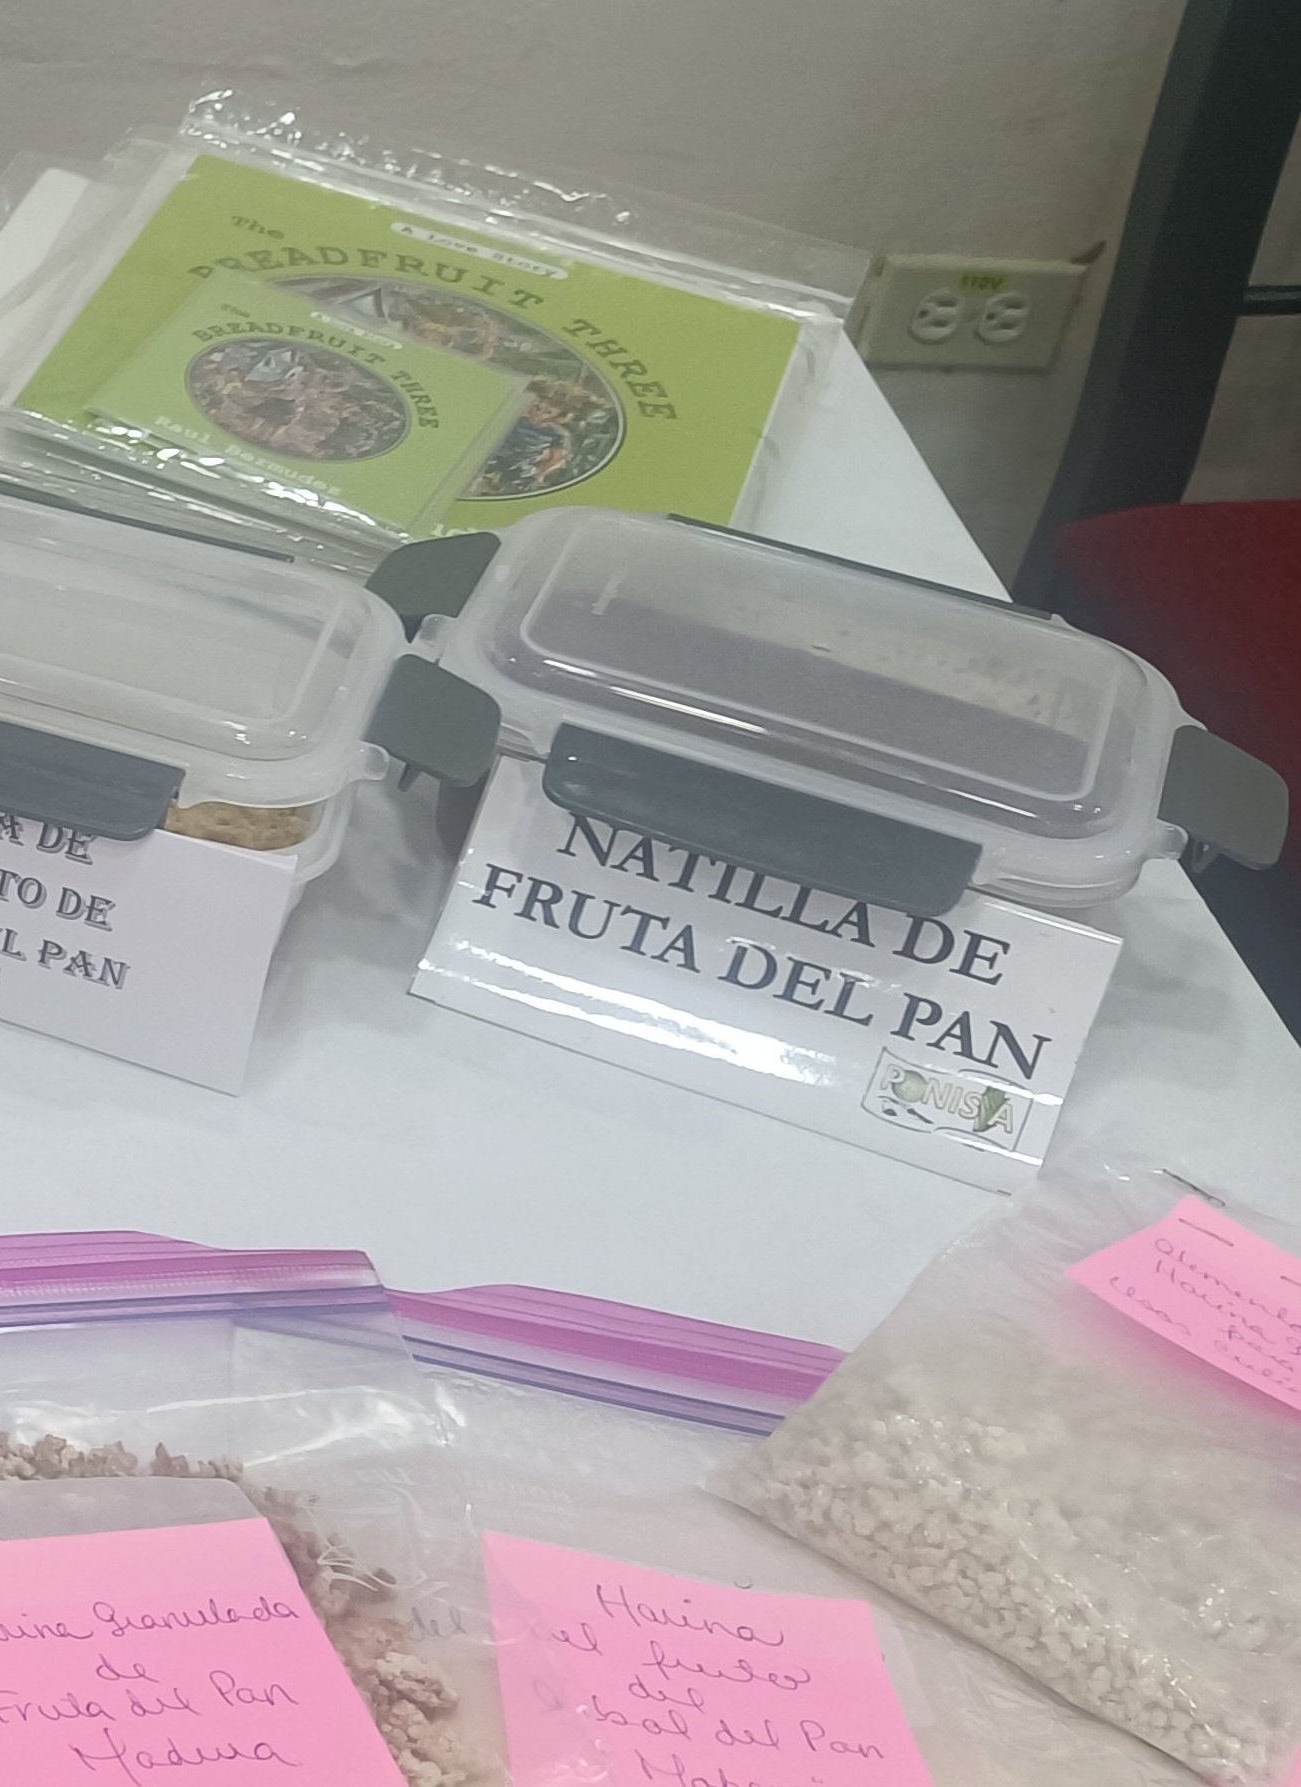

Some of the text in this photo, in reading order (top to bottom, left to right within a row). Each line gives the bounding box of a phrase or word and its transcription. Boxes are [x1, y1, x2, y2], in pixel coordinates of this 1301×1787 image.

[192, 321, 385, 364] BREADFRUIT
[390, 369, 439, 430] THREE
[562, 317, 677, 422] THREE
[36, 820, 97, 865] DE
[57, 886, 116, 932] DE
[556, 814, 1010, 986] NATILLA DE
[38, 939, 130, 990] PAN
[472, 863, 1053, 1079] FRUTA DEL PAN
[595, 1583, 785, 1647] Harina
[208, 1669, 300, 1708] Pan
[800, 1719, 885, 1760] Pan
